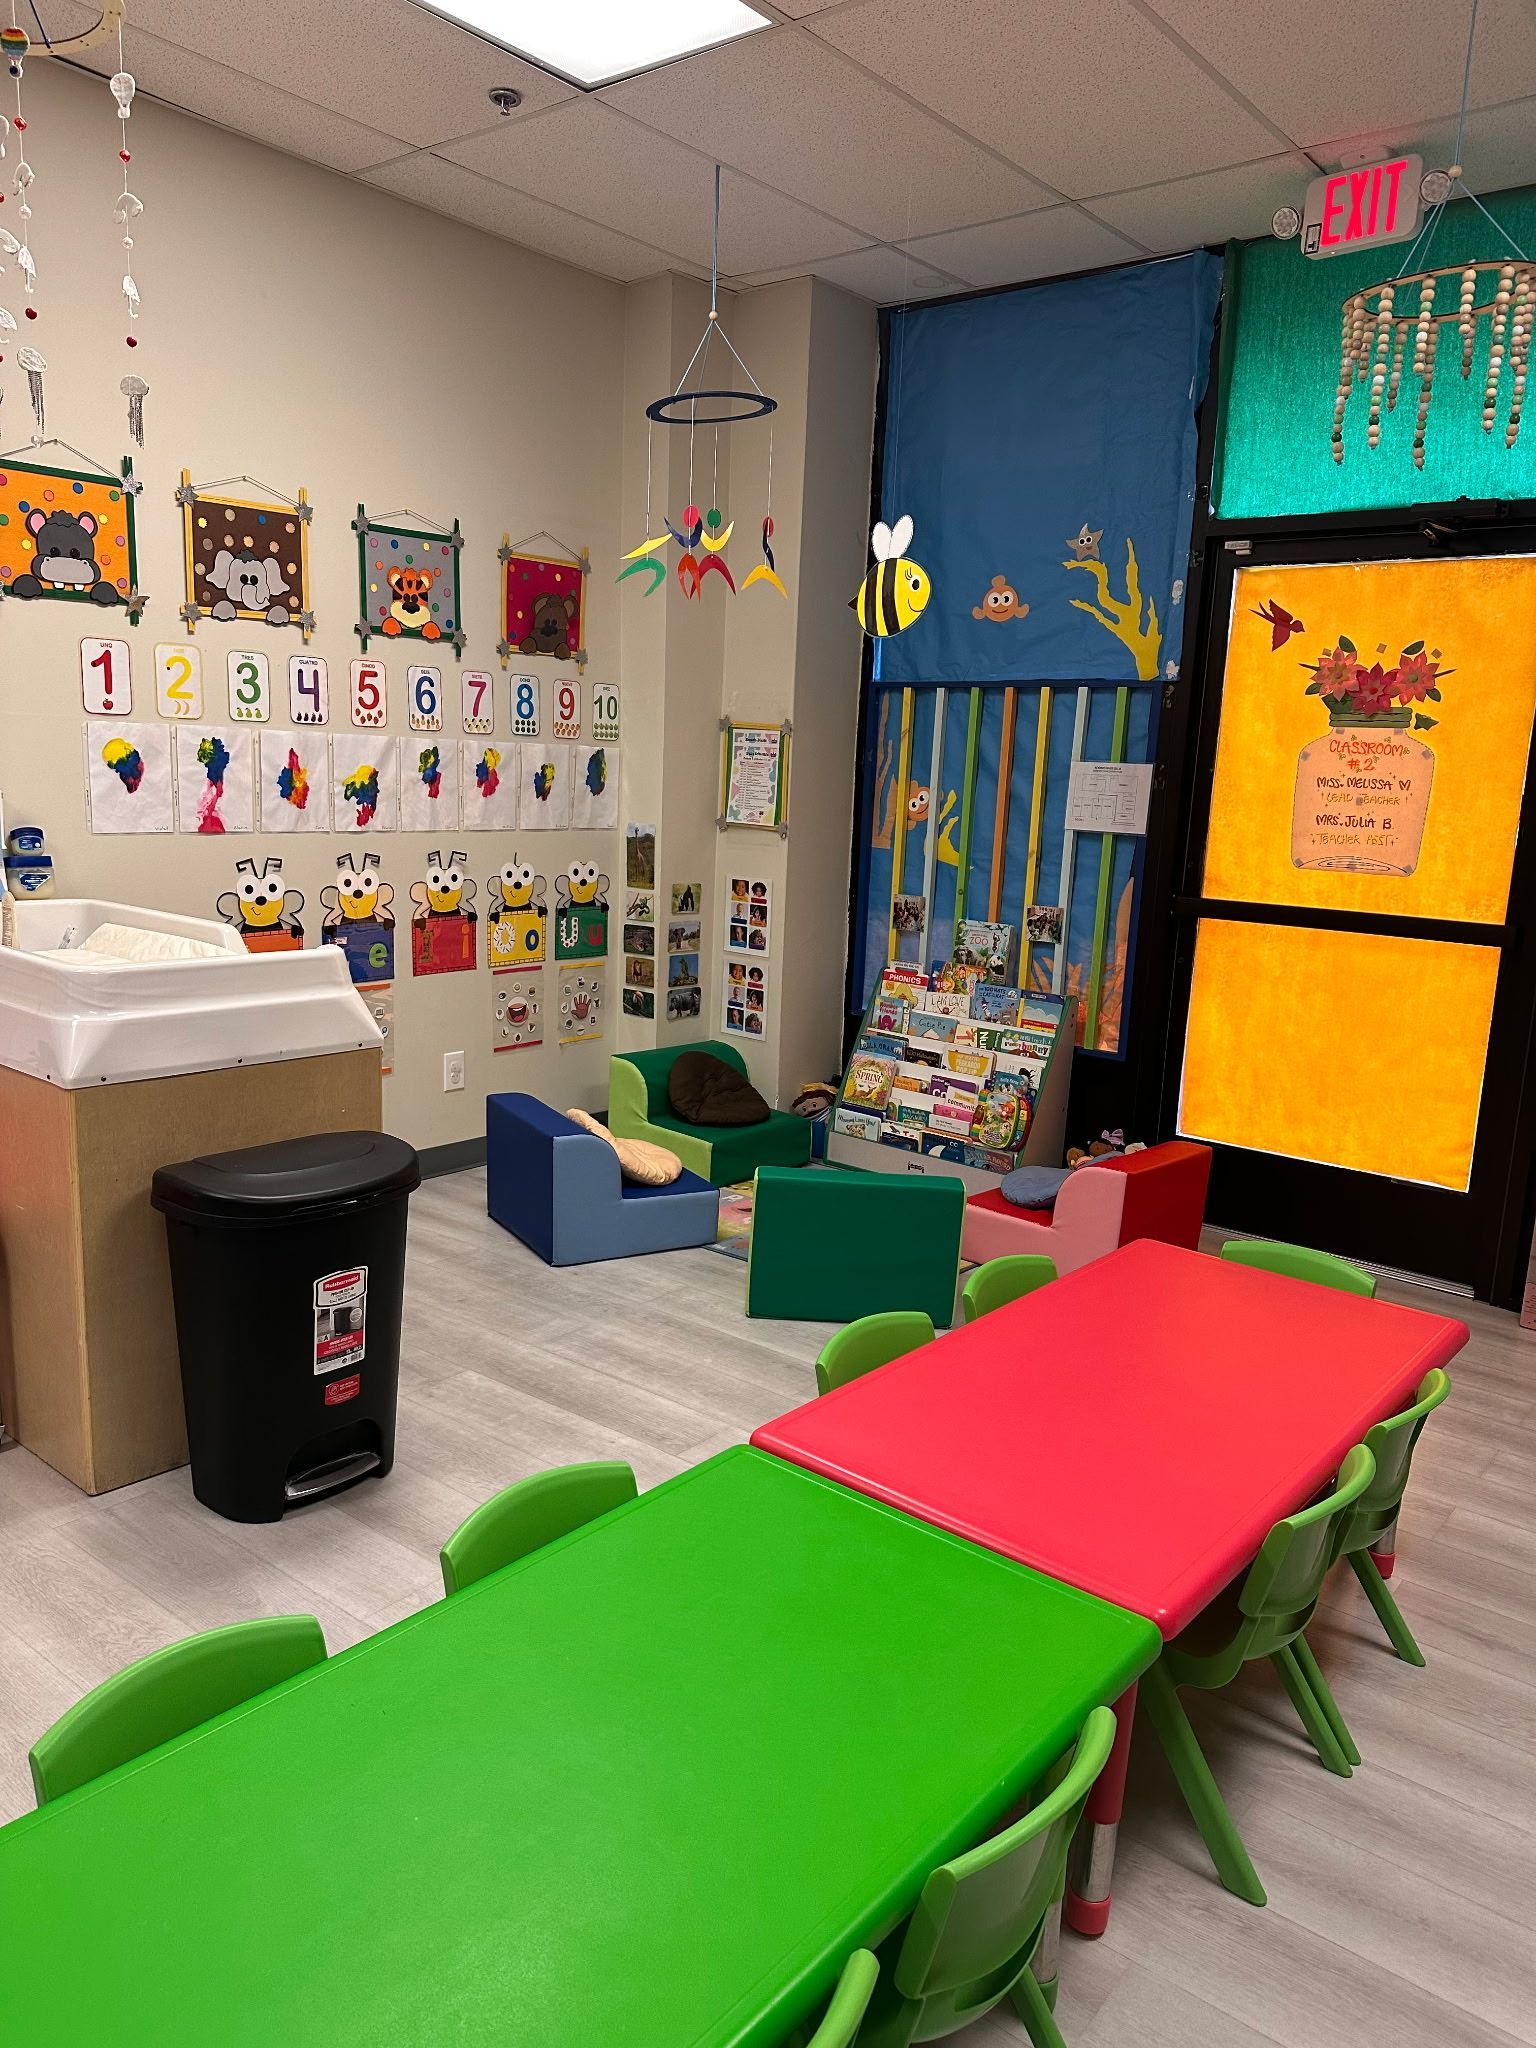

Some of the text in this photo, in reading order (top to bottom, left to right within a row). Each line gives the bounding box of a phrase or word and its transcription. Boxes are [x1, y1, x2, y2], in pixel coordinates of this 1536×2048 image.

[1320, 160, 1408, 247] EXIT
[91, 650, 113, 695] 1
[166, 655, 194, 699] 2
[237, 662, 261, 704] 3
[297, 668, 320, 712] 4
[357, 670, 380, 710] 5
[415, 676, 437, 715] 6
[468, 681, 486, 717] 7
[516, 683, 534, 720] 8
[558, 687, 575, 720] 9
[594, 695, 618, 720] 10
[1329, 739, 1404, 757] CLASSROOM
[1347, 778, 1393, 791] MELISSA
[1359, 794, 1400, 806] TEACHER
[1345, 815, 1377, 829] JULIA
[1318, 833, 1360, 845] TEACHER
[560, 917, 578, 948] U
[969, 936, 989, 947] ZOO
[368, 943, 388, 968] e
[889, 973, 922, 985] PHONICS
[855, 1070, 883, 1084] SPRING
